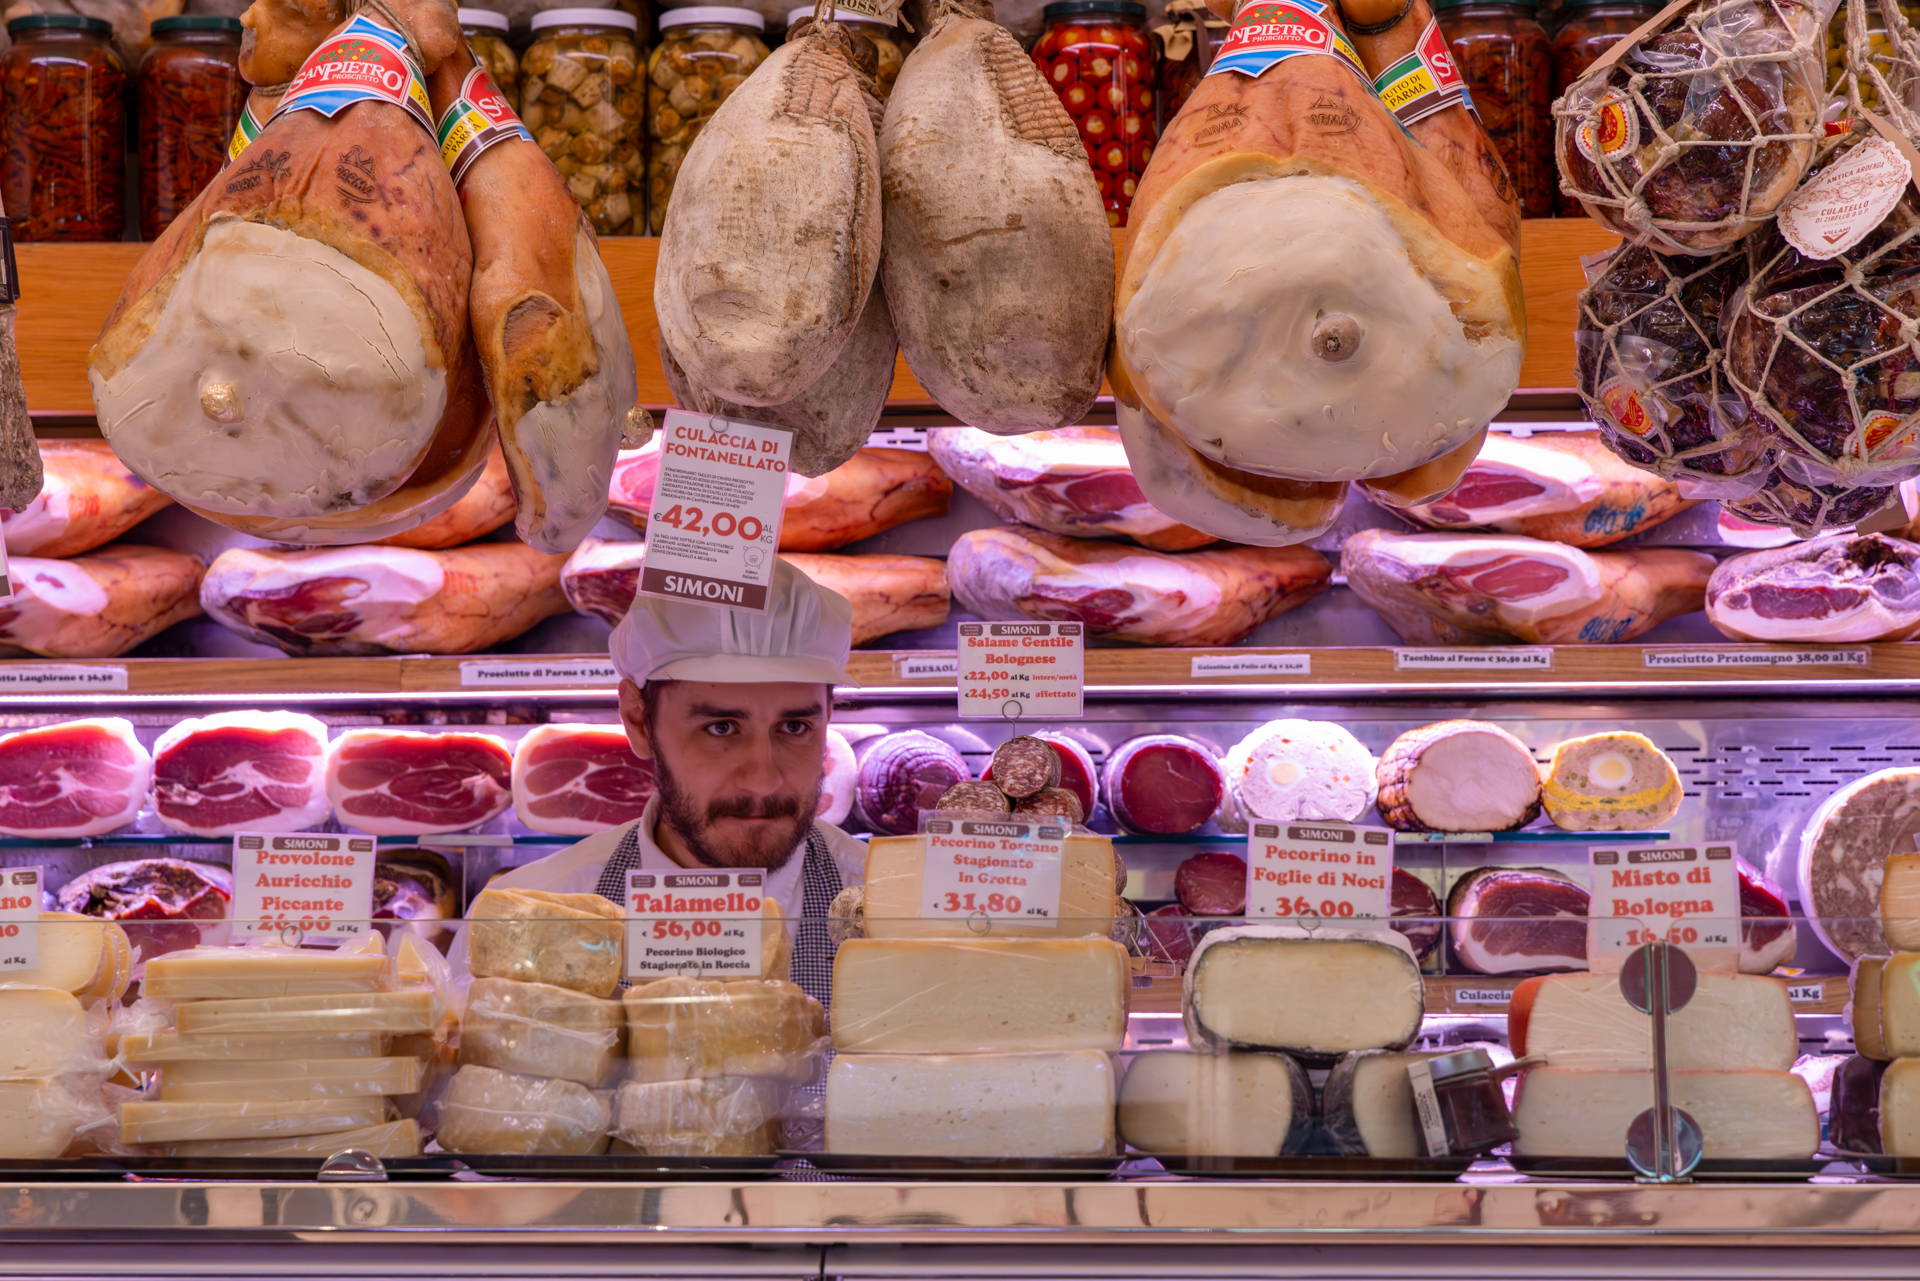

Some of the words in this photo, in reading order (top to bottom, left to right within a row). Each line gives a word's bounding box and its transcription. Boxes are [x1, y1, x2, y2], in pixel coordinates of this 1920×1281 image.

[1222, 24, 1325, 46] ANPIETRO
[1252, 34, 1301, 42] PROSCIUTTO
[289, 61, 403, 93] SANPIETRO
[331, 74, 379, 83] PROSCIUTTO
[1409, 74, 1421, 85] DI
[1390, 83, 1426, 107] PARMA
[463, 117, 473, 126] DI
[451, 123, 481, 152] PARMA
[335, 165, 374, 197] PARMA
[1827, 170, 1853, 184] ANTICA
[1821, 200, 1869, 216] CULATELLO
[1824, 212, 1850, 222] ZIBELLO
[1823, 226, 1851, 236] VILLANI
[675, 426, 757, 452] CULACCIA
[762, 440, 778, 454] DI
[666, 442, 786, 472] FONTANELLATO
[714, 480, 746, 489] FONTANELLATO
[762, 524, 774, 534] AL
[759, 535, 773, 544] KG
[664, 575, 744, 603] SIMONI
[1001, 625, 1040, 634] SIMONI
[968, 637, 1018, 647] Salame
[1022, 637, 1073, 647] Gentile
[985, 653, 1056, 666] Bolognese
[1403, 654, 1444, 662] Tacchino
[1447, 654, 1455, 662] al
[1458, 654, 1485, 662] Forno
[1496, 655, 1520, 664] 30,50
[1523, 654, 1531, 662] al
[1533, 655, 1546, 664] Kg
[1648, 654, 1713, 663] Prosciutto
[1717, 653, 1792, 665] Pratomagno
[1796, 653, 1829, 663] 38,00
[1832, 653, 1843, 661] al
[1847, 652, 1863, 663] Kg
[20, 674, 76, 683] Langhirano
[478, 668, 530, 678] Prosciutto
[533, 668, 543, 677] di
[545, 668, 578, 677] Parma
[588, 668, 615, 677] 36,50
[1032, 674, 1077, 682] intero/metà
[1035, 690, 1076, 698] affettato
[973, 824, 1018, 836] SIMONI
[1299, 829, 1343, 841] SIMONI
[284, 839, 328, 849] SIMONI
[931, 836, 996, 849] Pecorino
[999, 839, 1059, 854] Toscano
[256, 850, 355, 866] Provolone
[953, 854, 1034, 869] Stagionato
[1265, 845, 1351, 864] Pecorino
[1356, 851, 1376, 866] in
[1639, 851, 1685, 862] SIMONI
[255, 873, 353, 889] Auricchio
[676, 876, 718, 886] SIMONI
[958, 872, 974, 883] In
[978, 873, 1027, 886] Grotta
[1254, 867, 1312, 886] Foglie
[1317, 872, 1336, 886] di
[1342, 872, 1385, 889] Noci
[1611, 869, 1680, 888] Misto
[1686, 866, 1712, 883] di
[261, 896, 344, 911] Piccante
[631, 893, 761, 913] Talamello
[943, 892, 1022, 916] 31,80
[1036, 908, 1048, 916] Kg
[1611, 898, 1714, 918] Bologna
[347, 925, 358, 933] Kg
[653, 920, 722, 941] 56,00
[733, 929, 744, 937] Kg
[1625, 927, 1698, 945] 1650
[1714, 935, 1727, 943] Kg
[645, 947, 693, 957] Pecorino
[696, 947, 746, 957] Biologico
[14, 956, 27, 965] Kg
[640, 960, 699, 970] Stagionato
[715, 960, 750, 968] Roccia
[1459, 991, 1511, 1000] Culaccia
[1802, 989, 1820, 999] Kg
